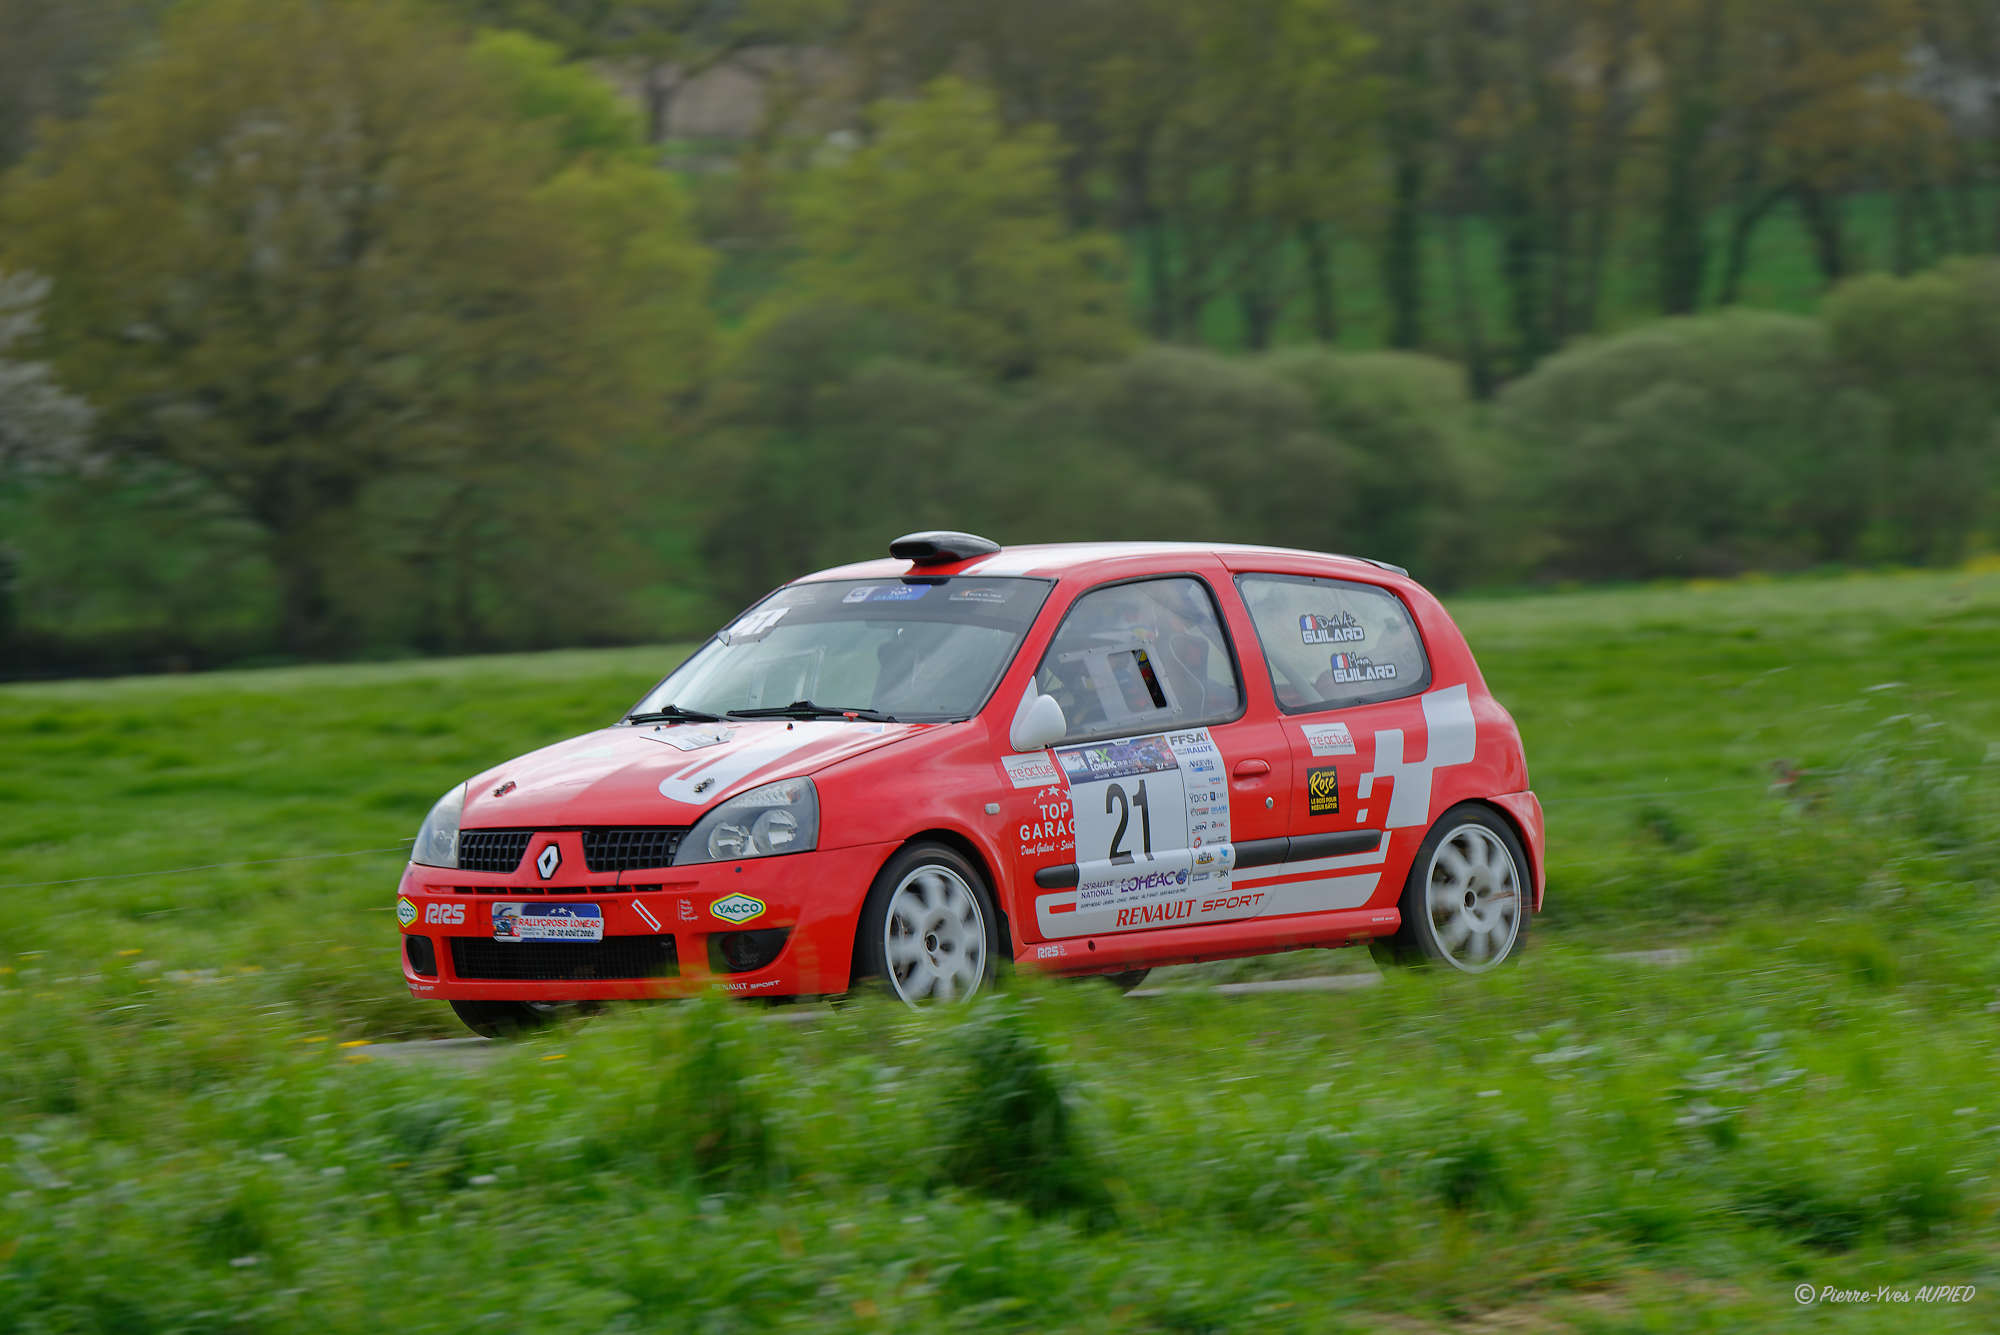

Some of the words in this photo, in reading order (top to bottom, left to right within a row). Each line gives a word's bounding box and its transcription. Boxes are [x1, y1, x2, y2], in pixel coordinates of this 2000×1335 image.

[1302, 626, 1364, 643] GUILARD
[1334, 664, 1396, 683] GUILARD
[1169, 732, 1205, 745] FFSA
[1309, 770, 1336, 797] Rose
[1040, 802, 1069, 820] TOP
[1105, 779, 1154, 866] 21
[1120, 870, 1176, 893] LOHÉAC
[1081, 887, 1114, 899] NATIONAL
[425, 903, 466, 924] RRS
[718, 903, 759, 914] YACCO
[1116, 899, 1197, 927] RENAULT
[1201, 893, 1265, 913] SPORT
[519, 917, 568, 927] RALLYCROSS
